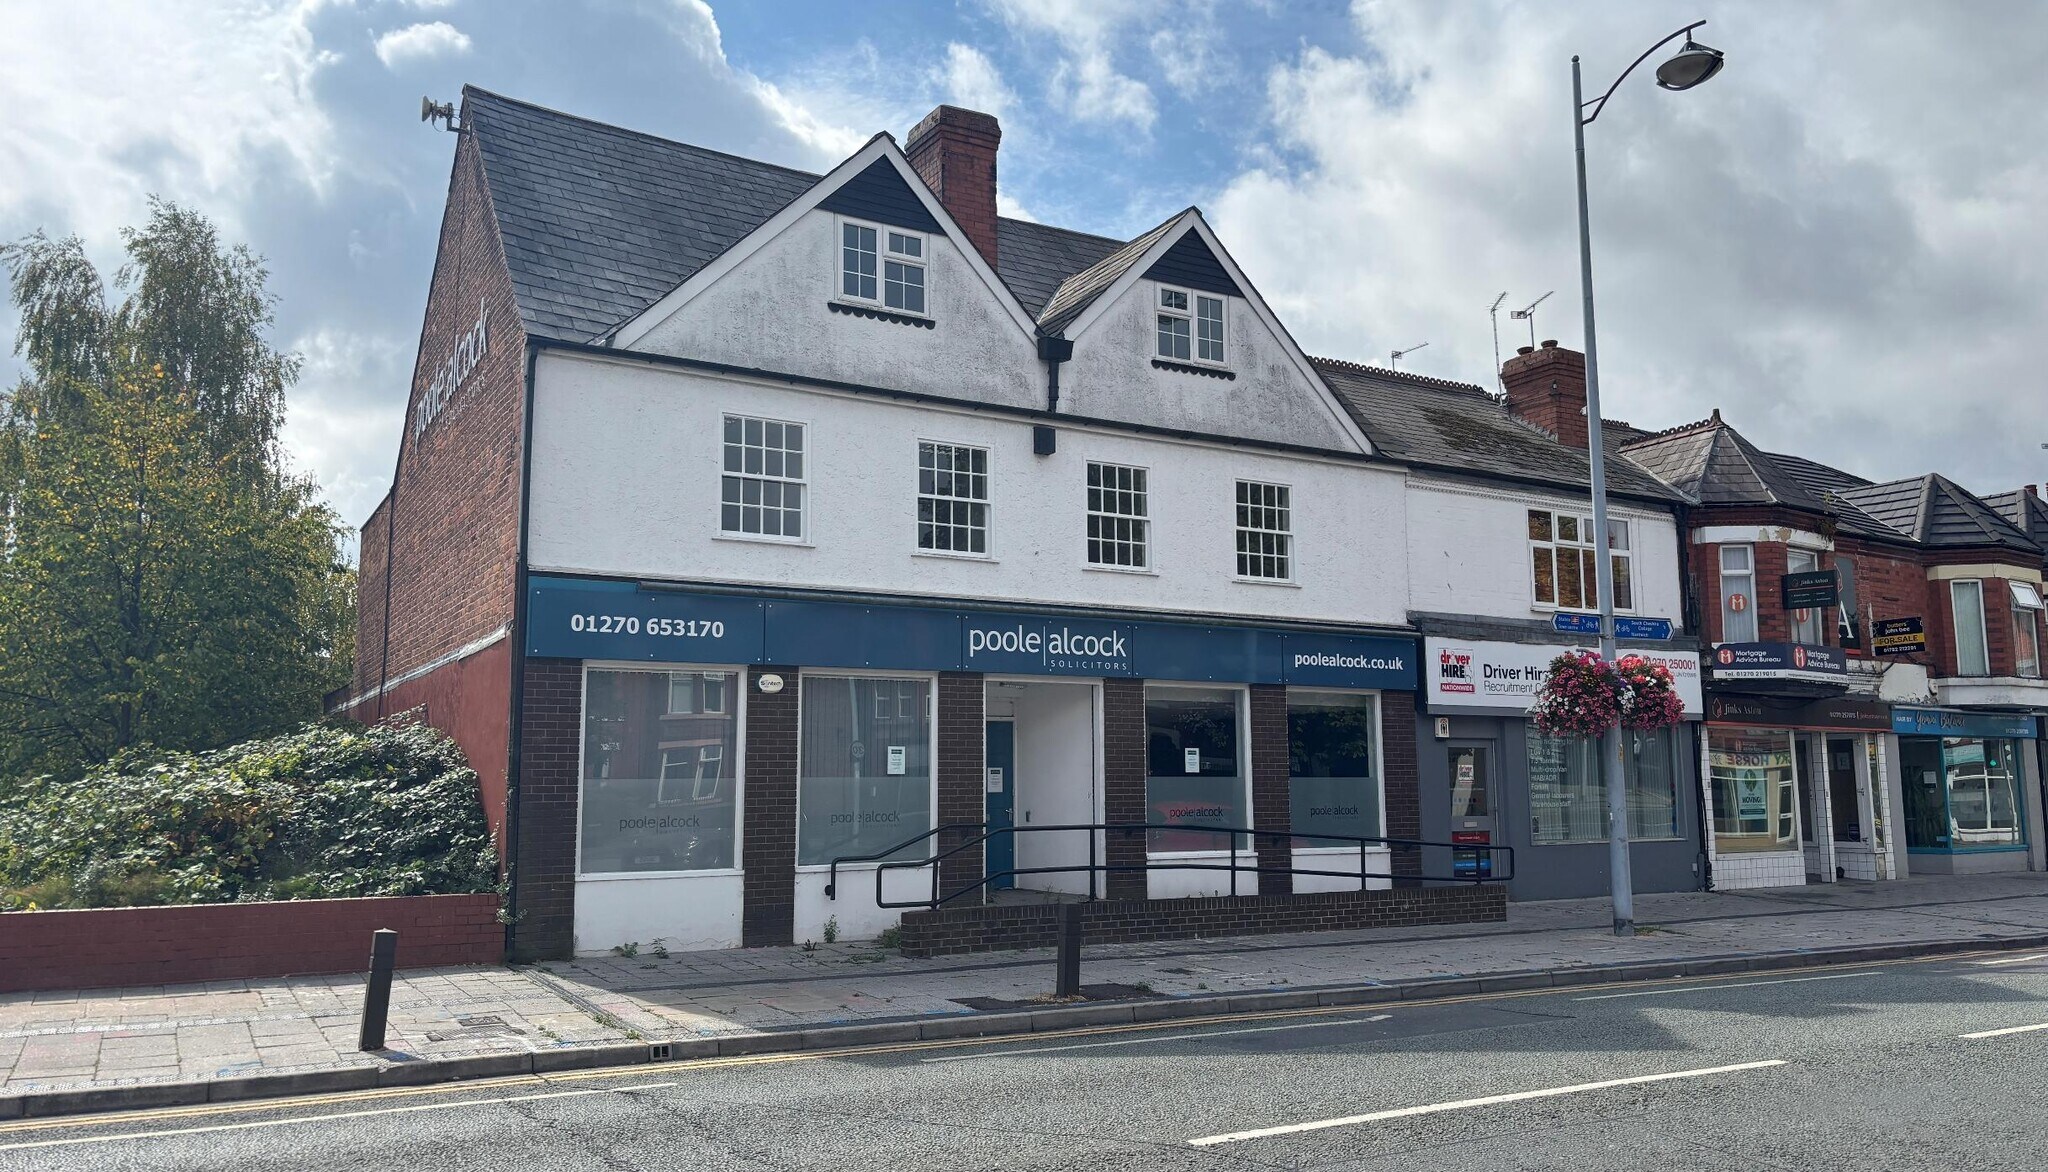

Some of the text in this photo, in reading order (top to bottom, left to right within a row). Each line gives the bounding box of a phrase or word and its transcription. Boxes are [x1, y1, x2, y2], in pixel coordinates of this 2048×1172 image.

[414, 363, 445, 455] poole
[446, 297, 488, 402] alcock
[571, 613, 725, 639] 01270 653170
[969, 625, 1127, 658] poole alcock
[1879, 634, 1919, 645] FOR SALE
[1294, 652, 1404, 671] poolealcock.co.uk
[1806, 650, 1830, 660] Mortgage
[1050, 659, 1128, 671] SOLICITORS
[1441, 664, 1465, 679] HIRE
[1483, 664, 1521, 680] Driver
[1668, 660, 1697, 670] 250001
[1806, 660, 1840, 670] Advice Bureau
[1441, 684, 1473, 692] NATIONWIDE
[1484, 680, 1534, 693] Recruitment
[830, 811, 862, 826] poole
[865, 810, 900, 823] alcock
[1169, 805, 1224, 819] poole alcock
[1310, 806, 1332, 818] poole
[1333, 804, 1359, 815] alcock
[619, 815, 700, 832] poole alcock
